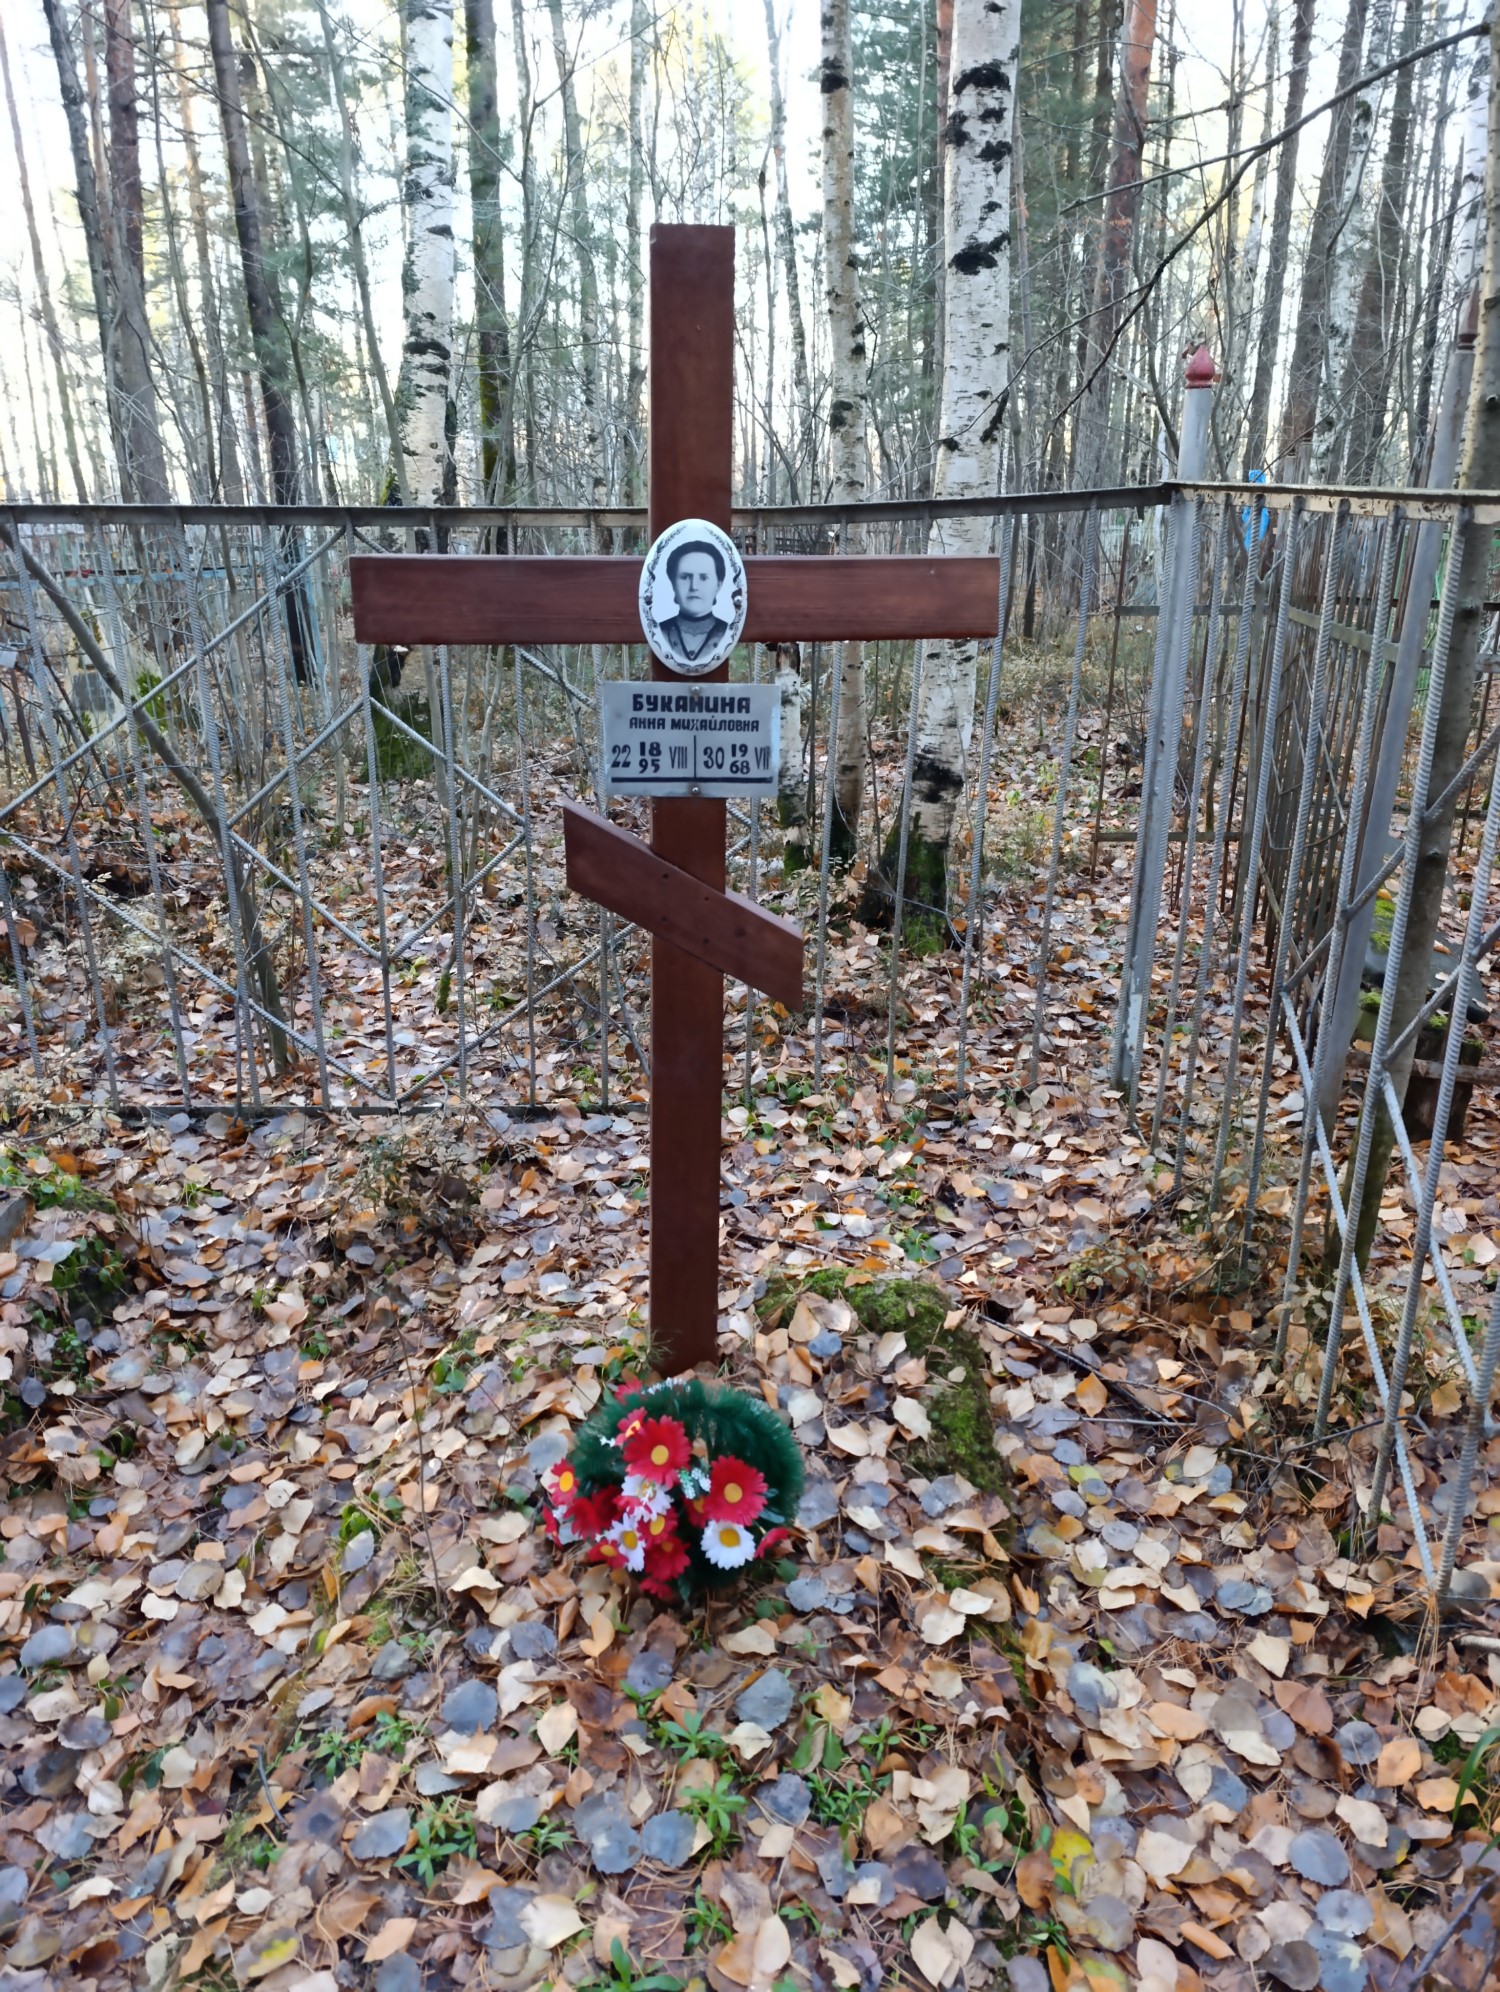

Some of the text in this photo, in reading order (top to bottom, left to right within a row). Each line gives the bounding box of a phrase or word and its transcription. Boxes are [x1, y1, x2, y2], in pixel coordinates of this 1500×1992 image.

[629, 717, 666, 730] АННА
[610, 744, 631, 768] 22
[639, 741, 662, 757] 18
[731, 743, 748, 758] 19
[638, 758, 661, 774] 95
[703, 746, 725, 770] 30
[729, 760, 751, 775] 68
